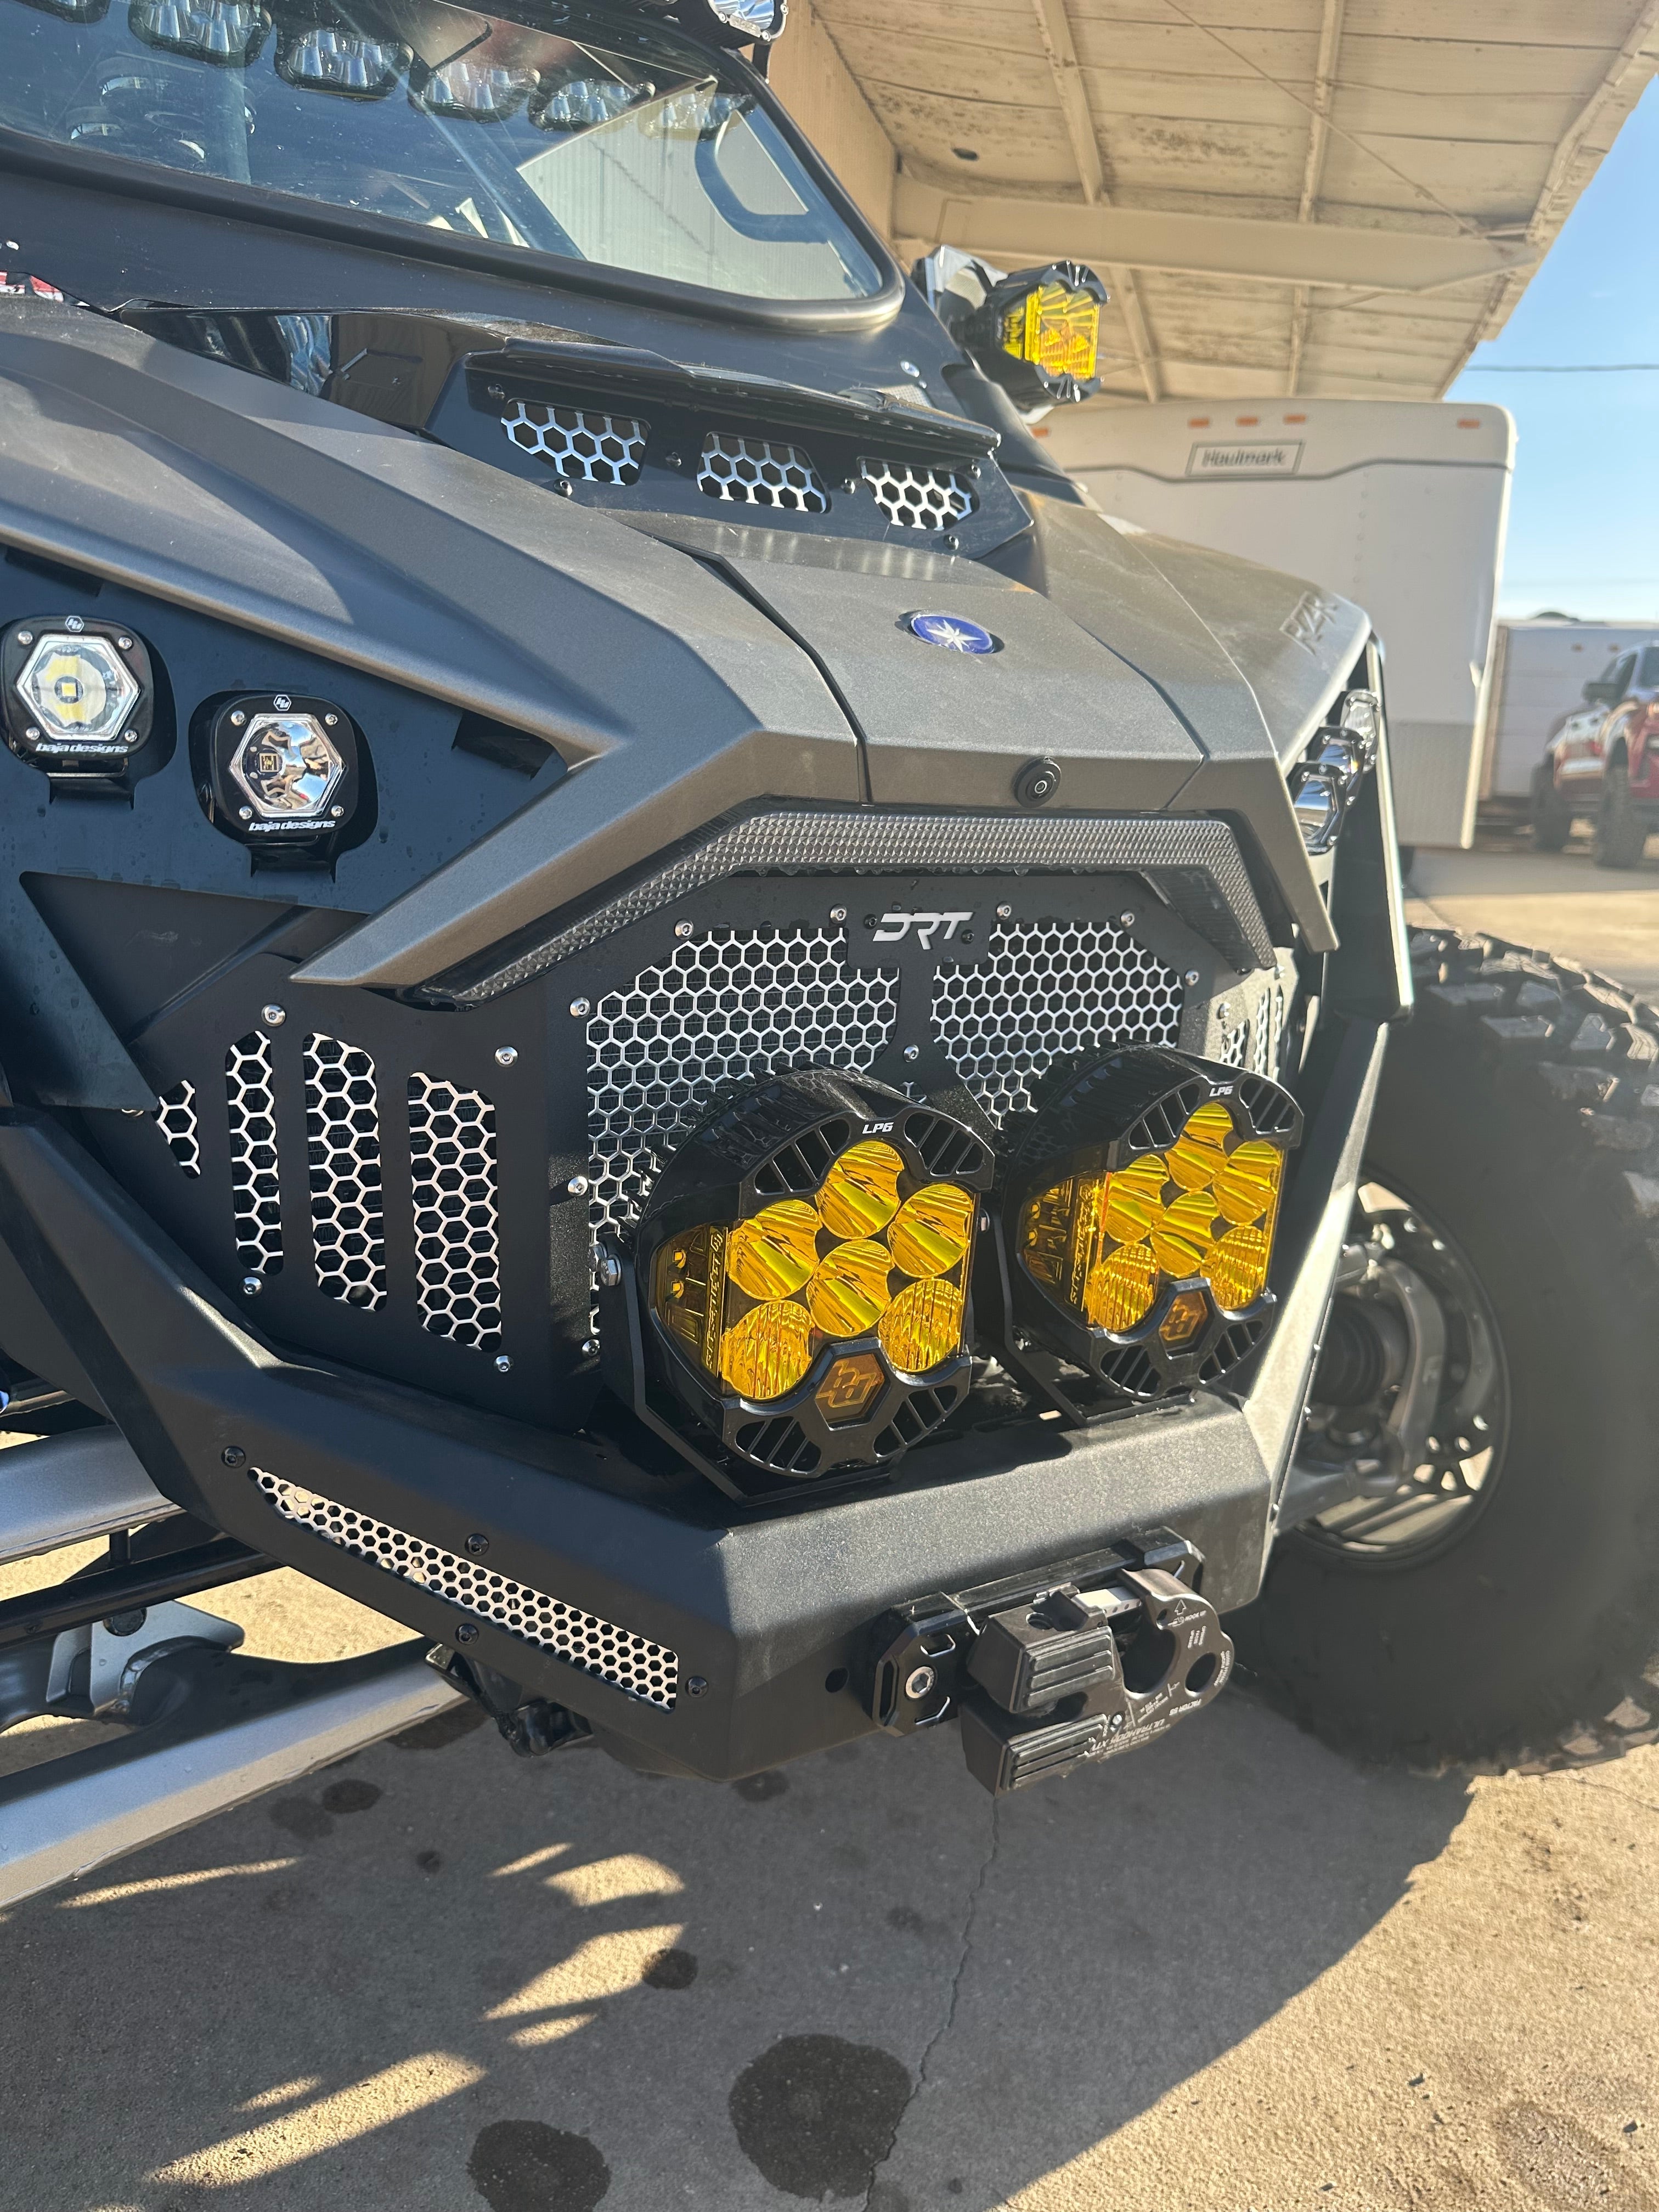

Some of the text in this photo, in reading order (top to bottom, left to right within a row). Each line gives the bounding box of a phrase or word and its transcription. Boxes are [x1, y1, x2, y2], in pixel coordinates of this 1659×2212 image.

[36, 743, 129, 753] baja designs
[249, 820, 335, 832] baja designs
[873, 912, 973, 950] DRT
[1209, 1086, 1234, 1097] LP6
[862, 1122, 894, 1134] LP6
